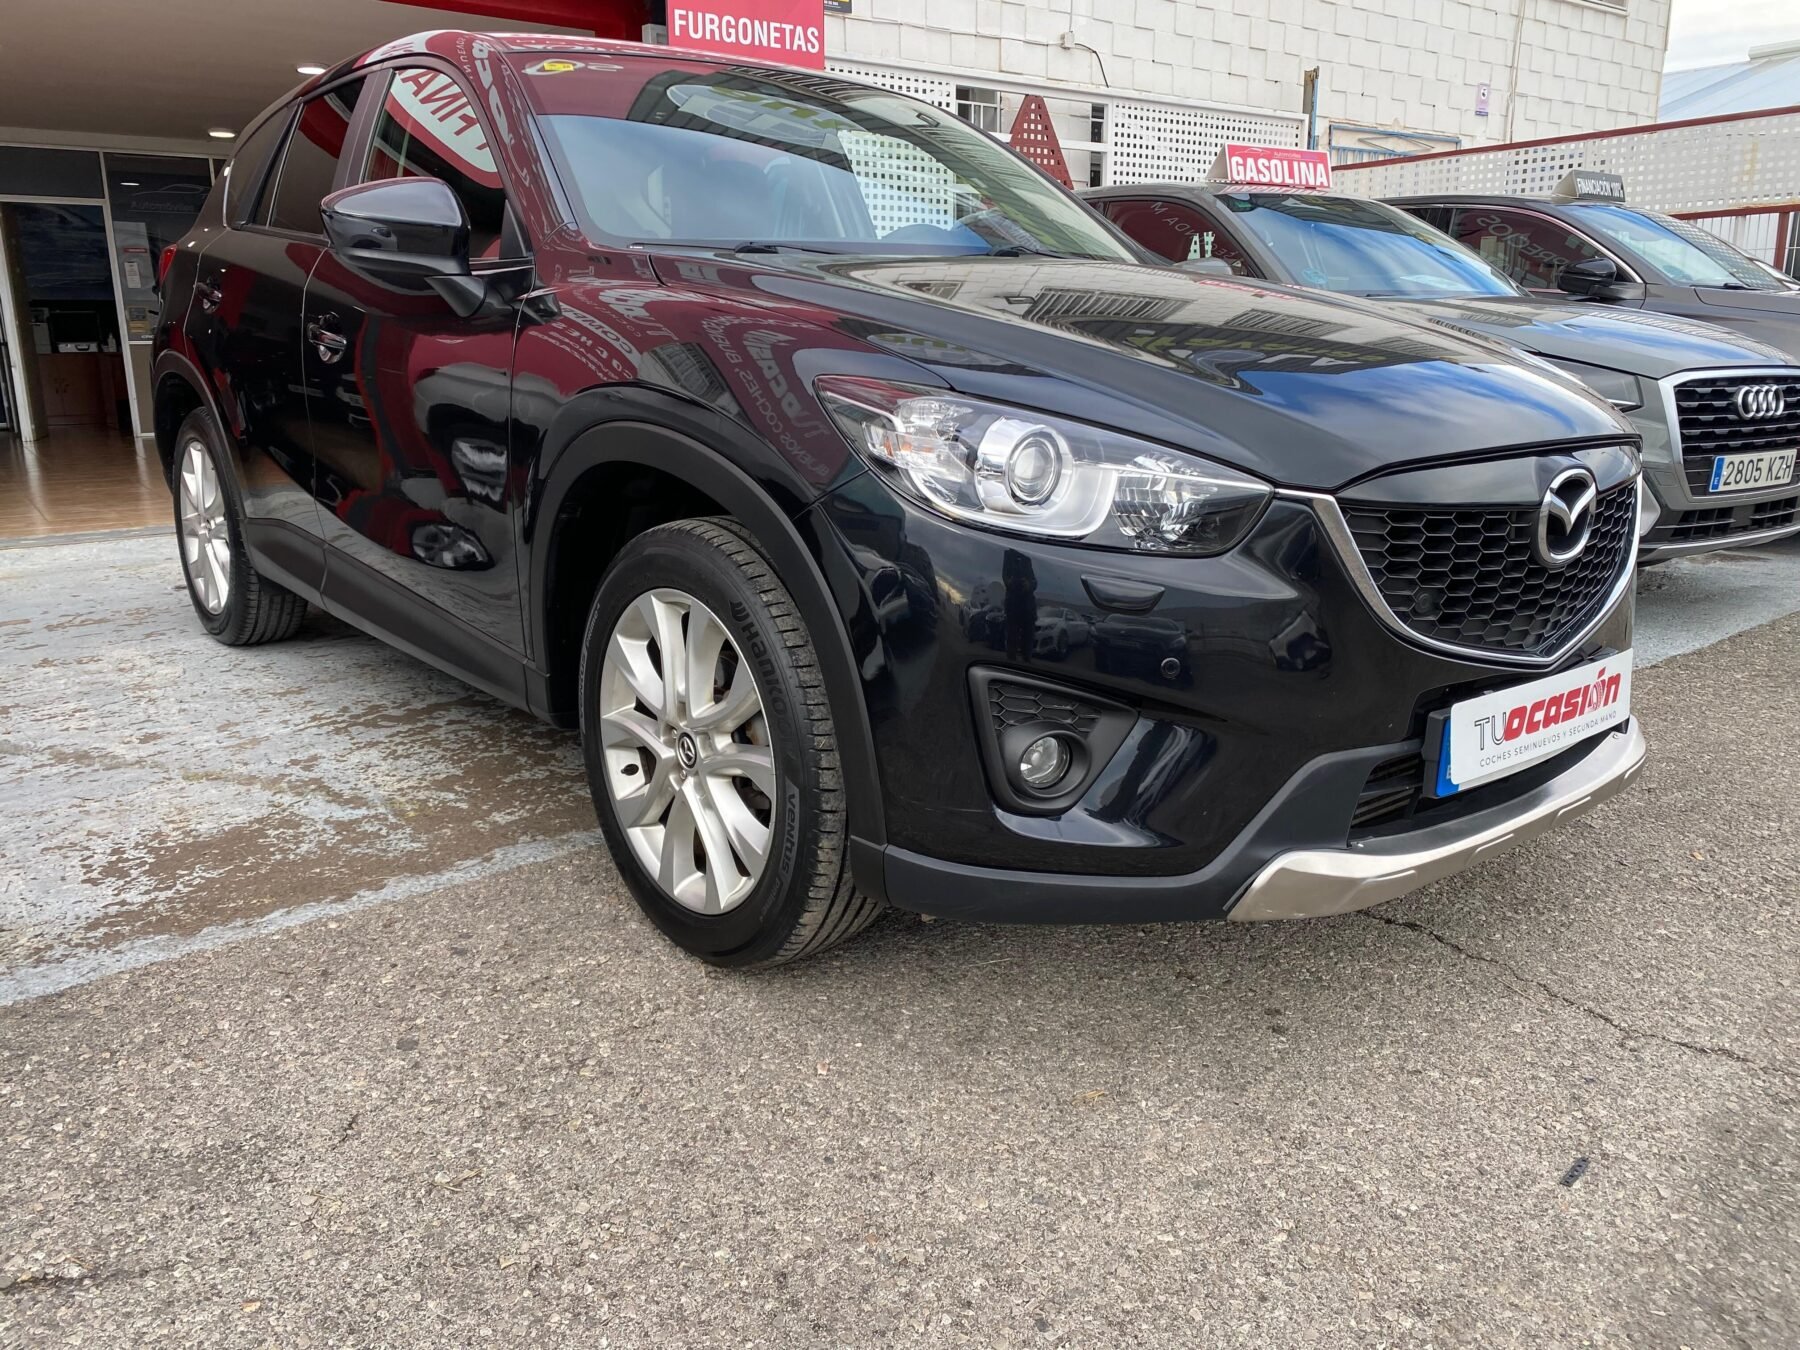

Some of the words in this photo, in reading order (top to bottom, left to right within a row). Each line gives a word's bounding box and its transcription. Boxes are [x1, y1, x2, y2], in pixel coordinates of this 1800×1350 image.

[674, 9, 820, 54] FURGONETAS
[1231, 156, 1329, 186] GASOLINA
[1723, 458, 1764, 486] 2805
[1766, 454, 1794, 482] KZH
[1479, 750, 1512, 767] COCHES
[1514, 734, 1561, 757] SEMINUEVOS
[1563, 730, 1567, 738] Y
[1601, 710, 1617, 722] MANO
